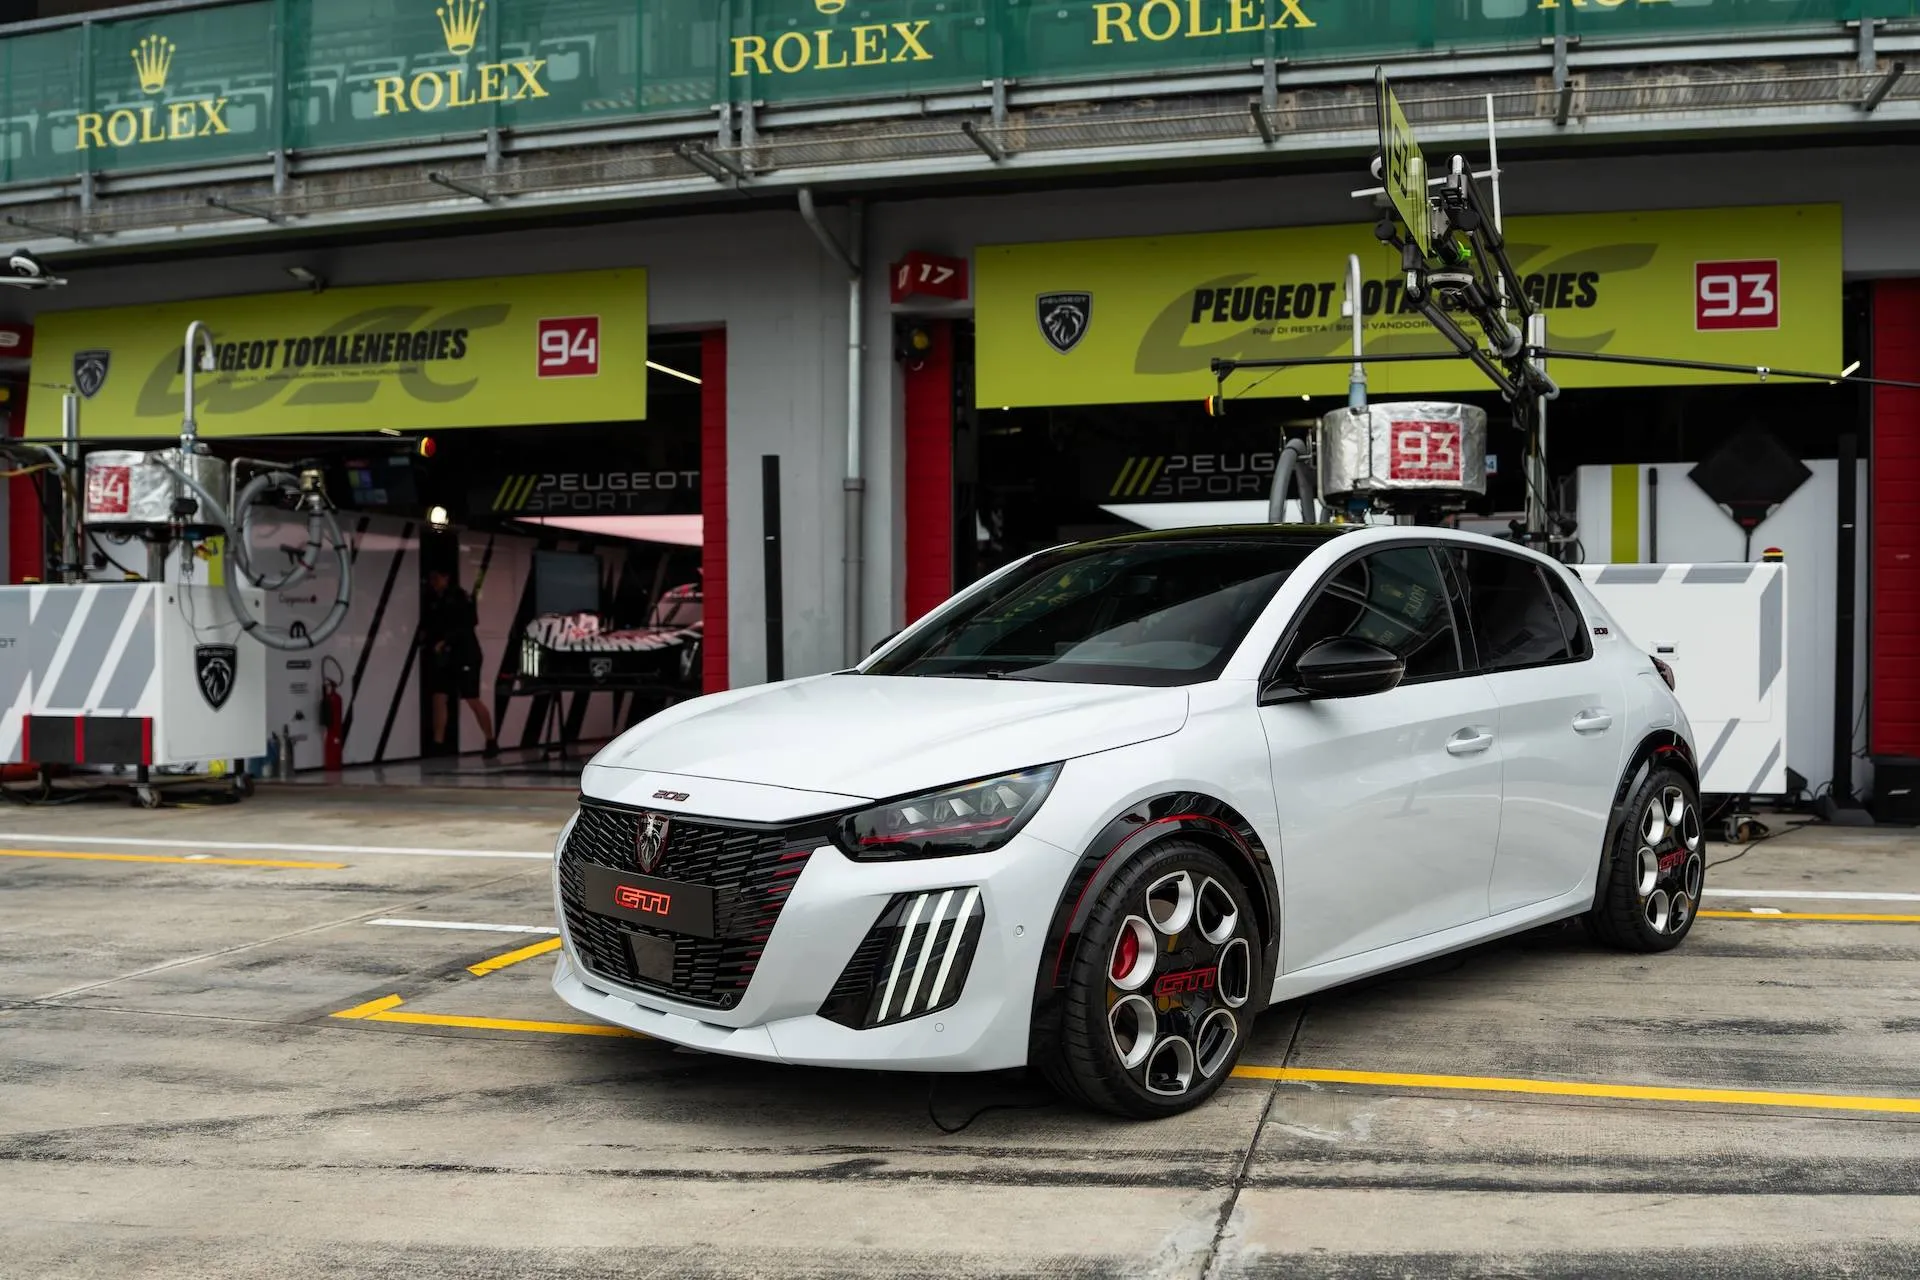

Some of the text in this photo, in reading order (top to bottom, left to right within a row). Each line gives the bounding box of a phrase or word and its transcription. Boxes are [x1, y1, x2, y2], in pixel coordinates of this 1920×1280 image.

[1092, 0, 1317, 44] ROLEX
[730, 20, 933, 76] ROLEX
[373, 60, 549, 116] ROLEX
[75, 98, 231, 149] ROLEX
[920, 263, 955, 284] 17
[1191, 282, 1336, 323] PEUGEOT
[1700, 273, 1774, 317] 93
[283, 328, 469, 369] TOTALENERGIES
[541, 328, 596, 367] 94
[1277, 326, 1289, 334] DI
[1291, 324, 1327, 333] RESTA
[1164, 452, 1275, 475] PEUG
[1397, 430, 1455, 470] 93
[536, 471, 700, 491] PEUGEOT
[1152, 474, 1273, 496] SPOR
[526, 491, 639, 511] SPORT
[652, 789, 690, 802] 208
